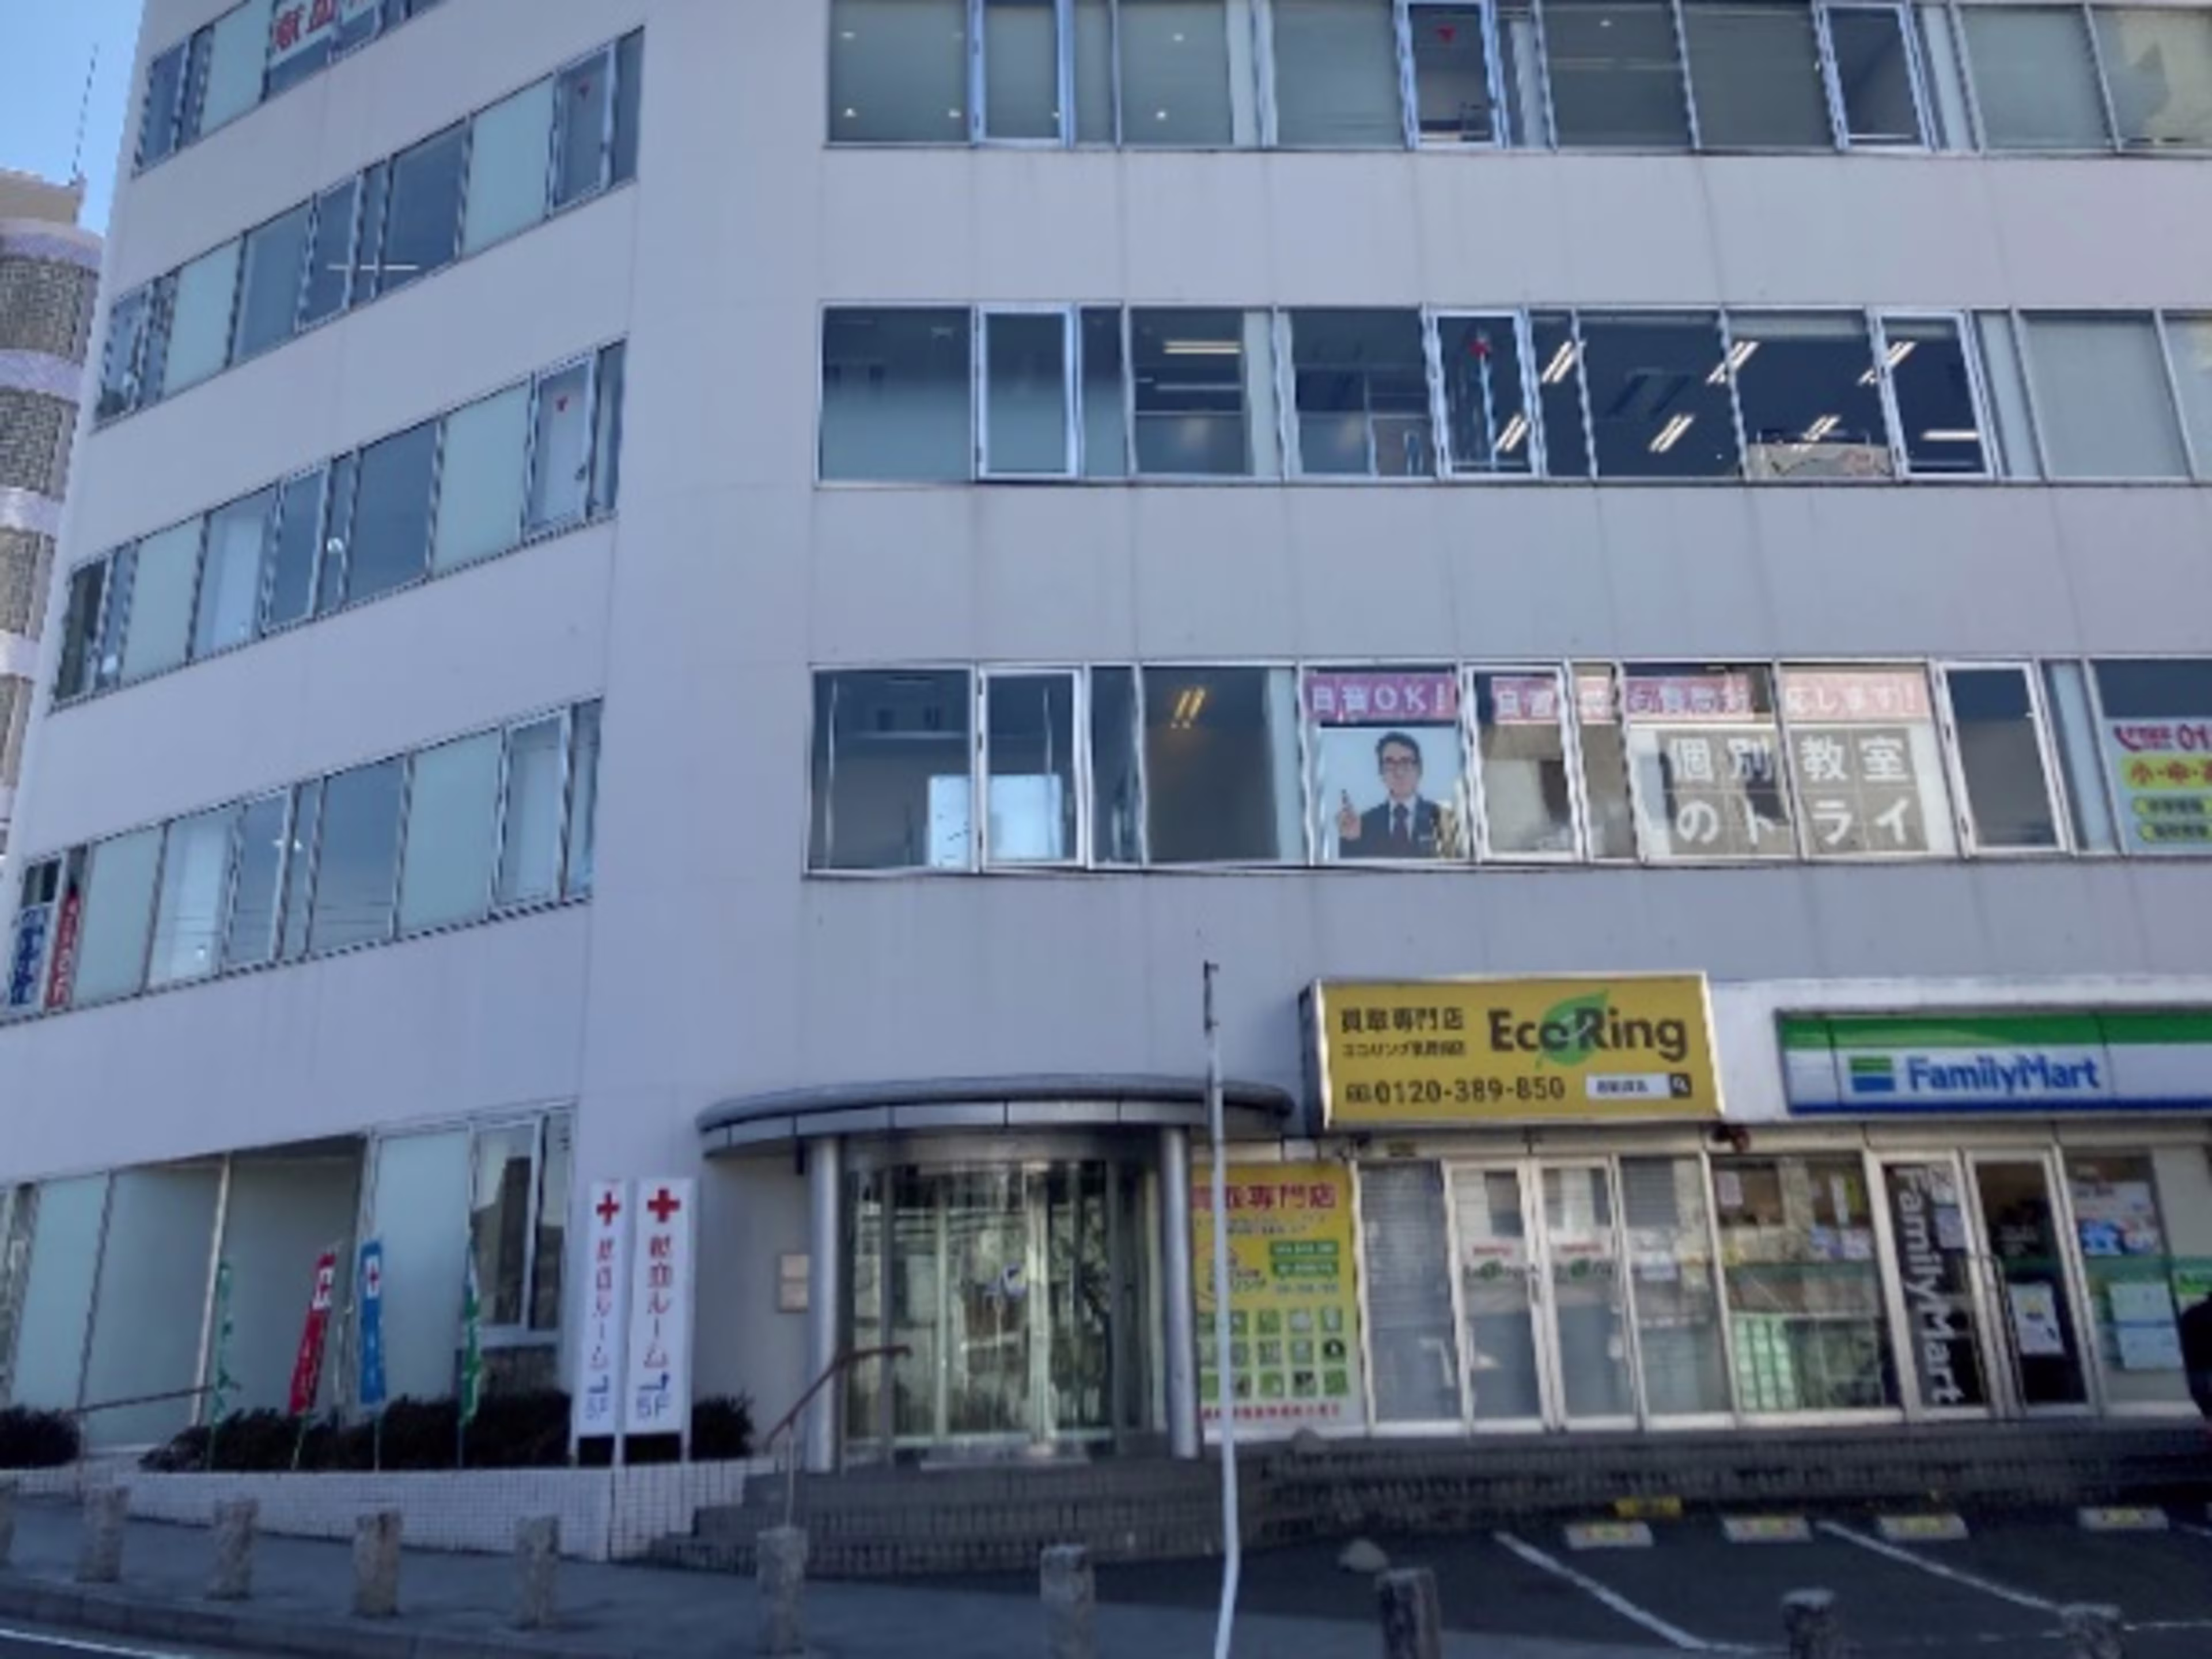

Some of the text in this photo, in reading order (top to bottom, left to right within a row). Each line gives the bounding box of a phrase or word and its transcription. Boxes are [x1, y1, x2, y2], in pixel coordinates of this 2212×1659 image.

[1669, 735, 1908, 782] 個別教室
[1676, 798, 1910, 846] のトライ
[1374, 1076, 1567, 1105] 0120-389-850
[1906, 1055, 2100, 1093] FamilyMart
